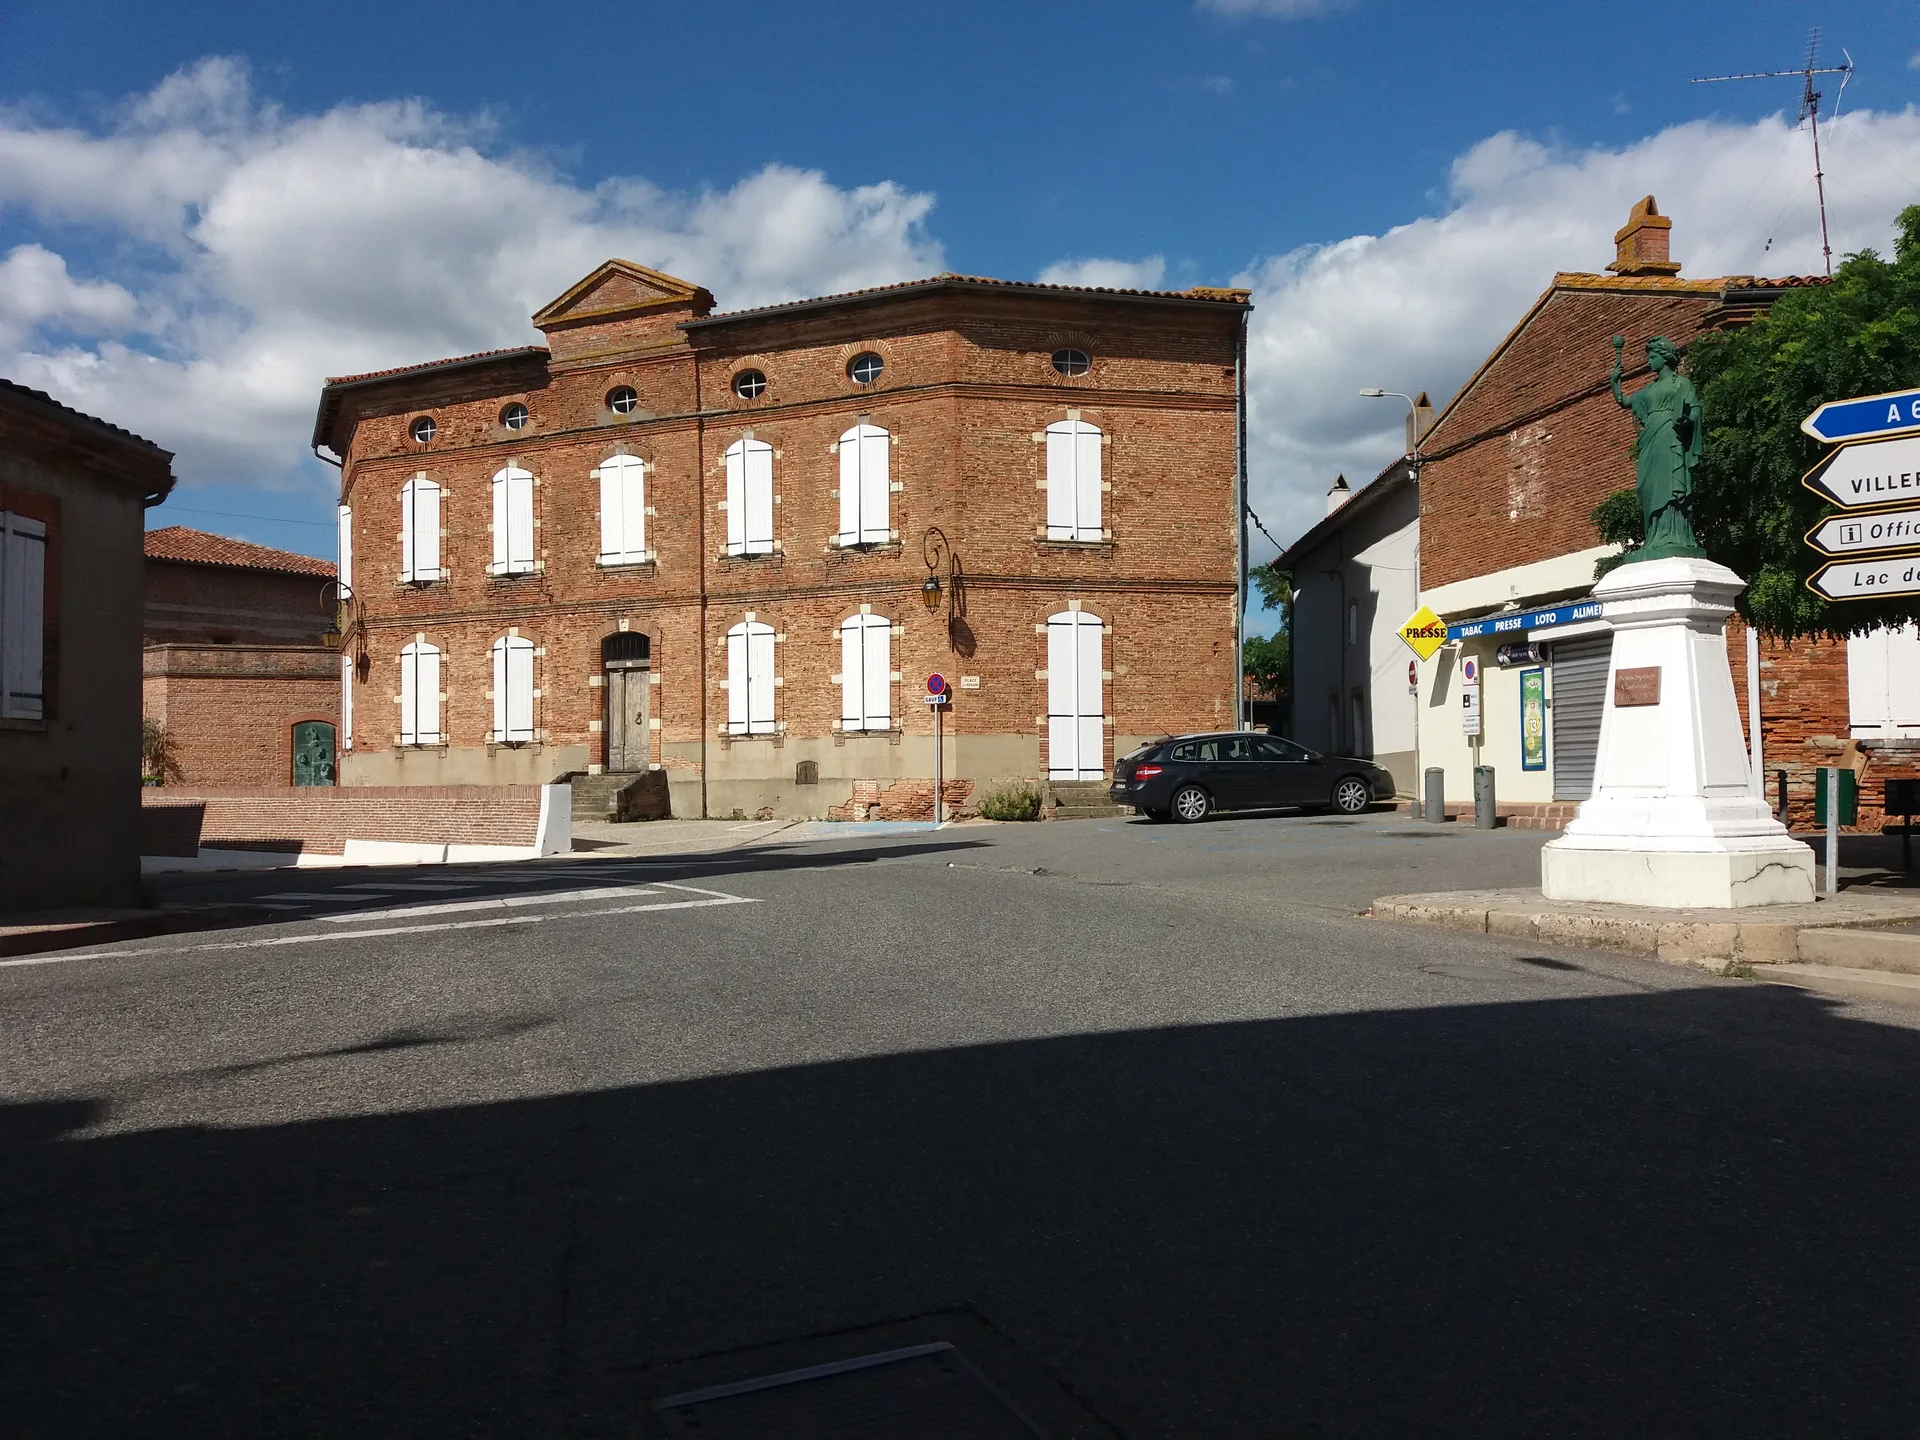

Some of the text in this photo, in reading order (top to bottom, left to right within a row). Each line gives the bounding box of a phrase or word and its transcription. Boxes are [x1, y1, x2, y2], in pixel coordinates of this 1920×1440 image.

[1887, 403, 1901, 423] A
[1870, 520, 1920, 539] Offic
[1854, 571, 1889, 587] Lac
[1406, 627, 1447, 638] PRESSE
[1461, 625, 1483, 637] TABAC
[1495, 618, 1522, 632] PRESSE
[1535, 613, 1557, 625] LOTO
